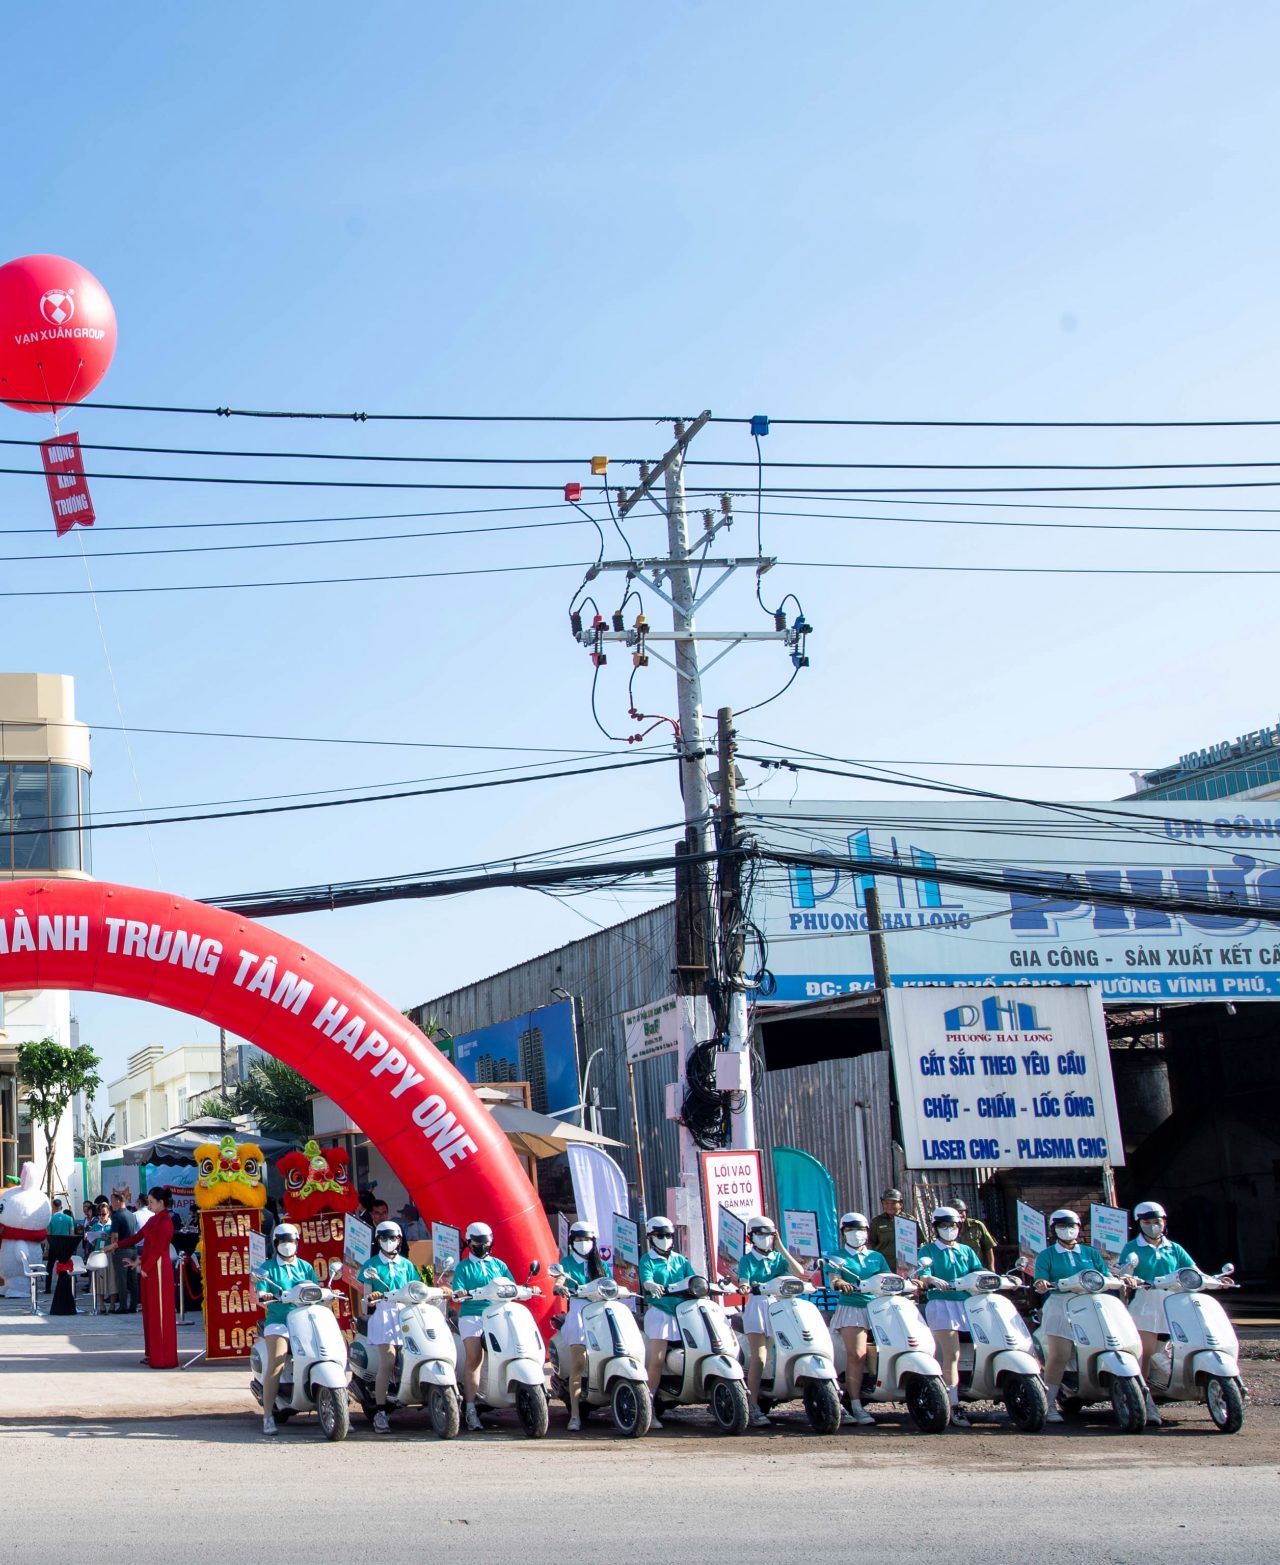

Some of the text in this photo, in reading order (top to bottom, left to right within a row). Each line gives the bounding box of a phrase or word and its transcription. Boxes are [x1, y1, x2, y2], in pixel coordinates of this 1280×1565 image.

[40, 326, 72, 341] XUÂN
[73, 327, 104, 340] GROUP
[919, 912, 971, 930] LONG
[1010, 950, 1042, 967] GIA
[1047, 946, 1099, 967] CÔNG
[1125, 945, 1161, 967] SẢN
[1166, 943, 1213, 966] XUẤT
[1219, 943, 1252, 965] KẾT
[1167, 976, 1217, 993] VĨNH
[1222, 975, 1272, 994] PHÚ,
[945, 1034, 1053, 1043] PHUONG HAI LONG
[232, 949, 315, 1016] TÂM
[311, 996, 426, 1100] HAPPY
[412, 1093, 480, 1171] ONE
[920, 1048, 1087, 1076] CẮT SẮT THEO YÊU CẦU
[923, 1093, 959, 1123] CHẶT
[977, 1091, 1017, 1118] CHẤN
[1032, 1090, 1061, 1118] LỐC
[1064, 1090, 1096, 1118] ỐNG
[921, 1138, 966, 1161] LASER
[969, 1138, 1001, 1160] CNC
[1016, 1137, 1076, 1160] PLASMA
[1077, 1137, 1108, 1159] CNC
[731, 1162, 751, 1177] VÀO
[717, 1183, 730, 1195] XE
[740, 1179, 753, 1194] TÔ
